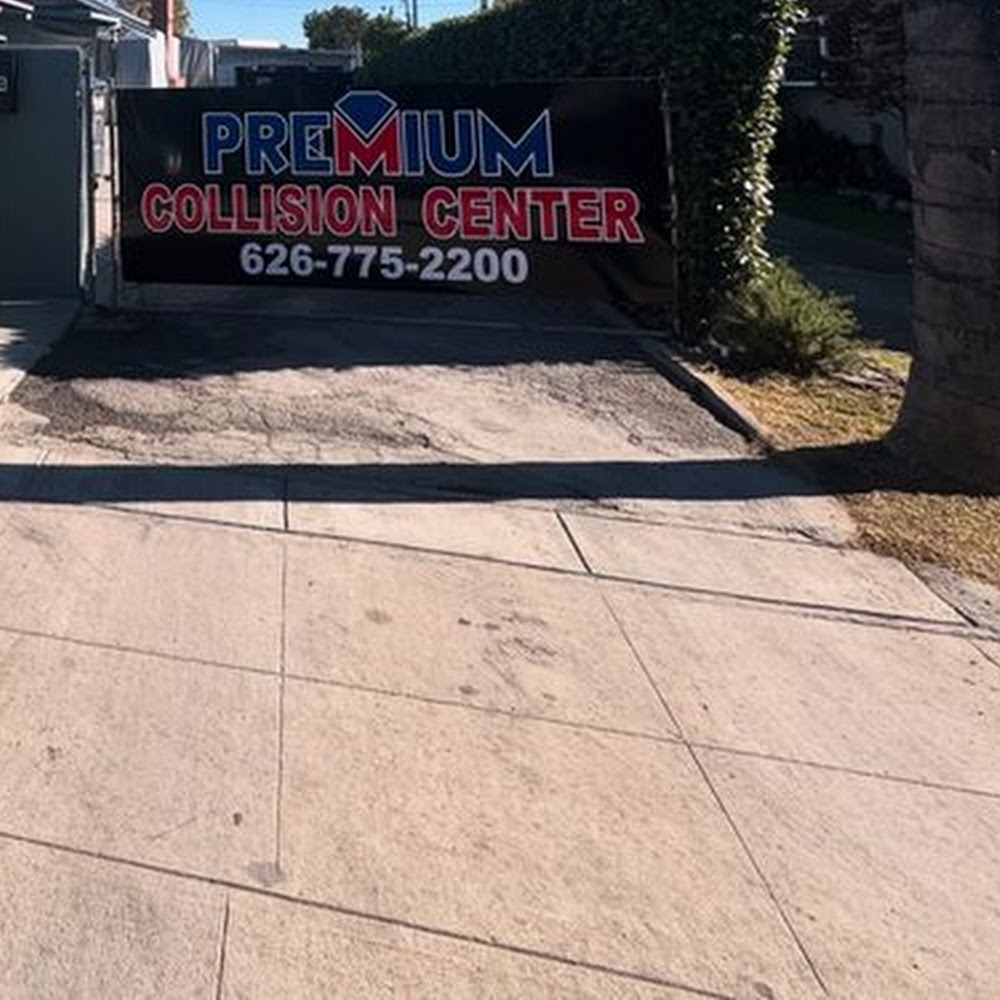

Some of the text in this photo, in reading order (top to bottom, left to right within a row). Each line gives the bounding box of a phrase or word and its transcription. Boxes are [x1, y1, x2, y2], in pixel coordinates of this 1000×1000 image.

[201, 91, 555, 178] PREMIUM
[140, 183, 645, 244] COLLISION CENTER
[239, 242, 529, 285] 626-775-2200
